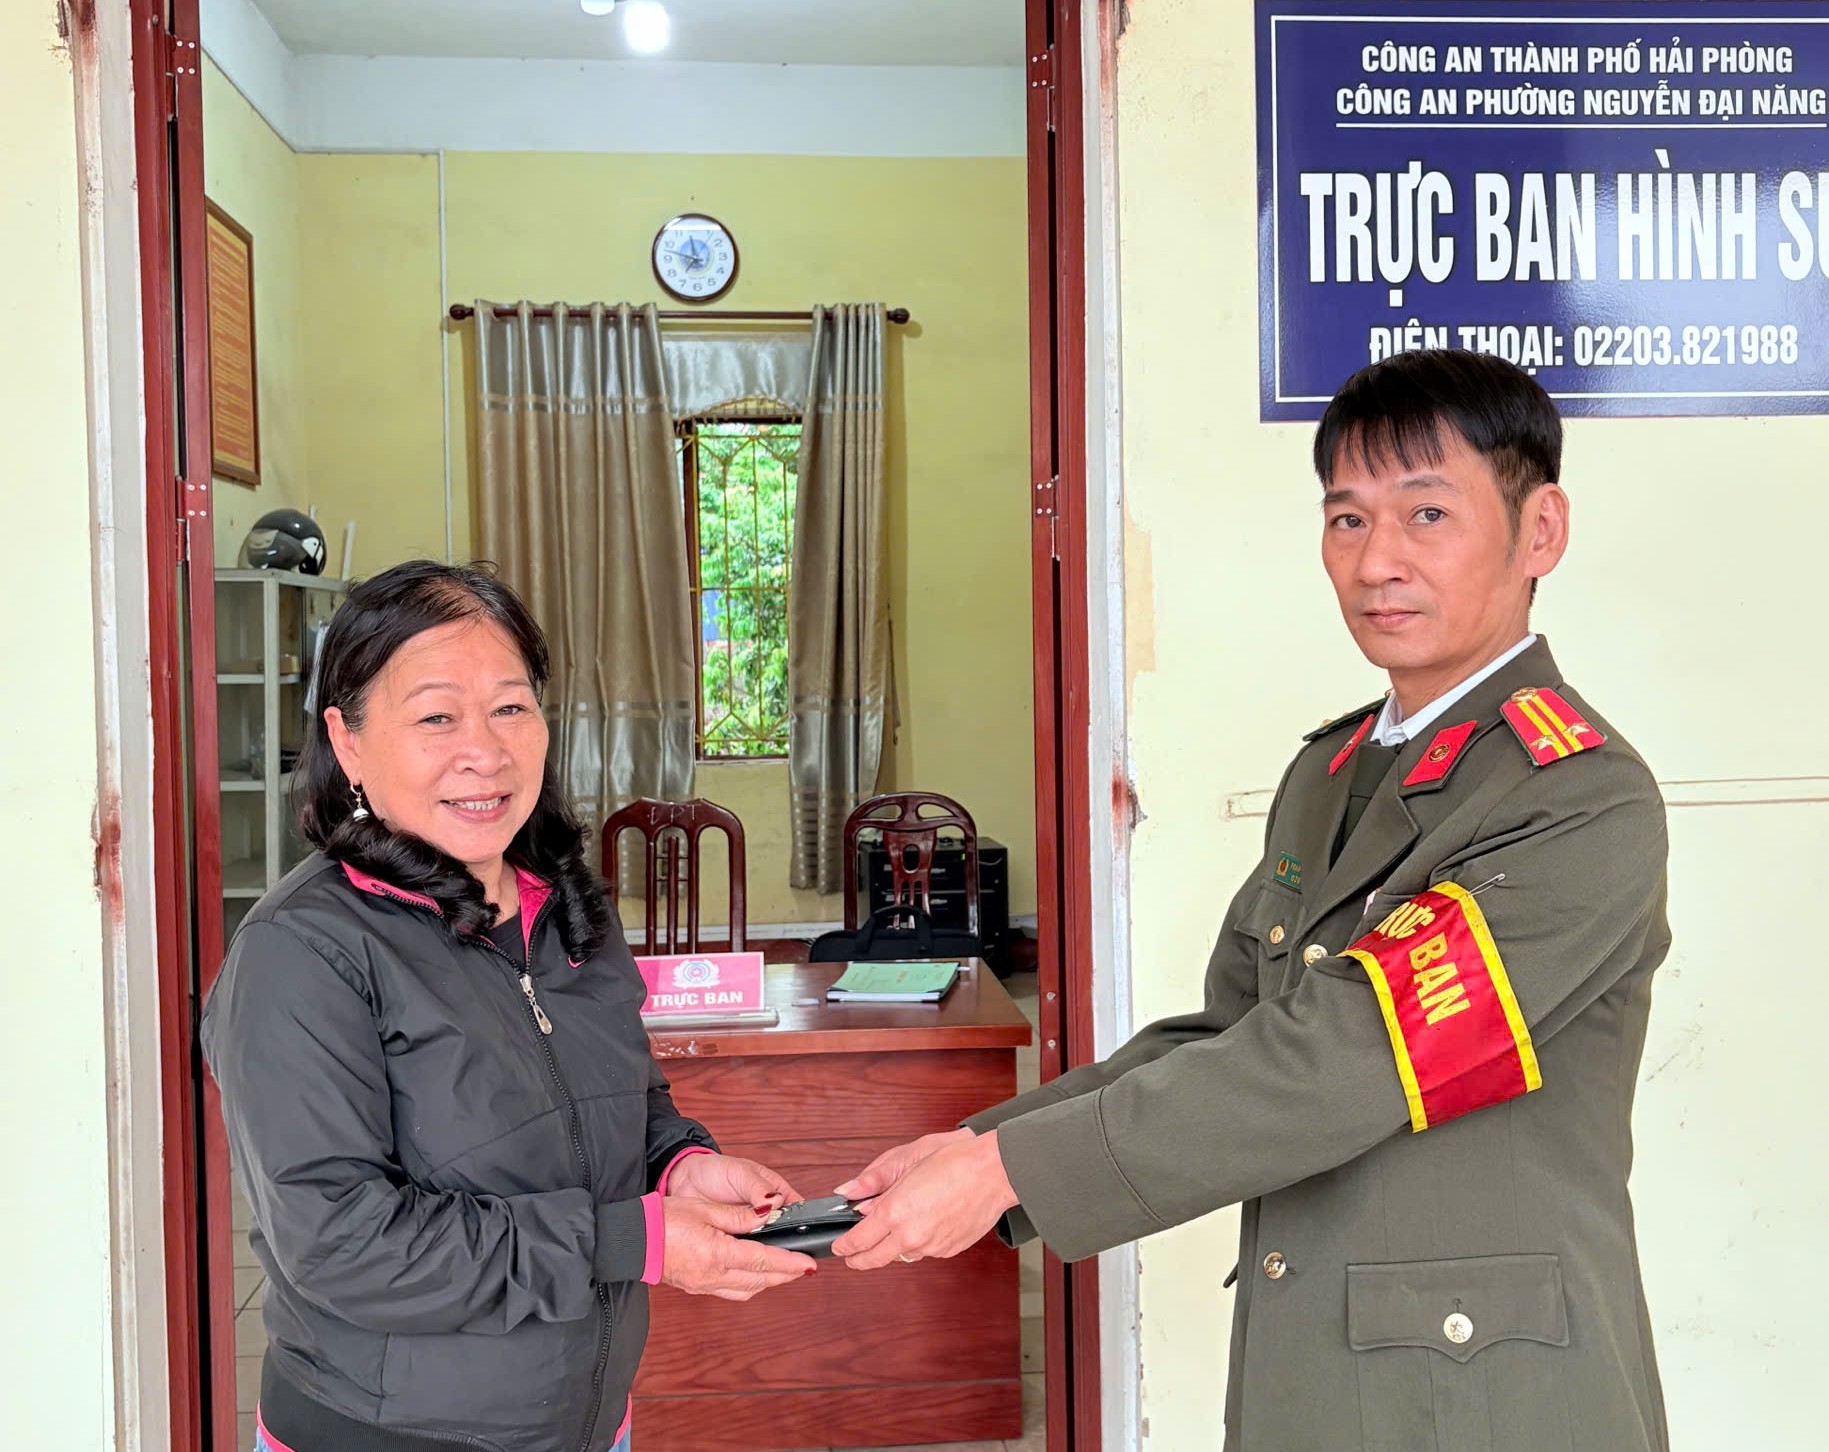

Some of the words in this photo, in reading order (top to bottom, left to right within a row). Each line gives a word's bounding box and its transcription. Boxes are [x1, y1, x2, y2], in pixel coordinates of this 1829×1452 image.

[1362, 40, 1436, 73] CÔNG
[1444, 46, 1483, 73] AN
[1490, 41, 1579, 73] THÀNH
[1587, 38, 1642, 73] PHỐ
[1650, 36, 1693, 73] HẢI
[1702, 40, 1793, 73] PHÒNG
[1336, 83, 1411, 115] CÔNG
[1419, 89, 1457, 115] AN
[1466, 82, 1575, 115] PHƯỜNG
[1583, 79, 1691, 115] NGUYỄN
[1698, 89, 1743, 121] ĐẠI
[1752, 83, 1827, 115] NĂNG
[1300, 160, 1455, 307] TRỰC
[1475, 172, 1597, 281] BAN
[1616, 148, 1757, 280] HÌNH
[663, 255, 673, 264] 9
[719, 252, 728, 261] 3
[679, 278, 687, 288] 7
[692, 283, 703, 292] 6
[707, 278, 717, 287] 5
[1574, 325, 1799, 366] 02203.821988
[1408, 931, 1471, 1026] BAN
[651, 992, 699, 1009] TRỰC
[704, 991, 744, 1005] BAN
